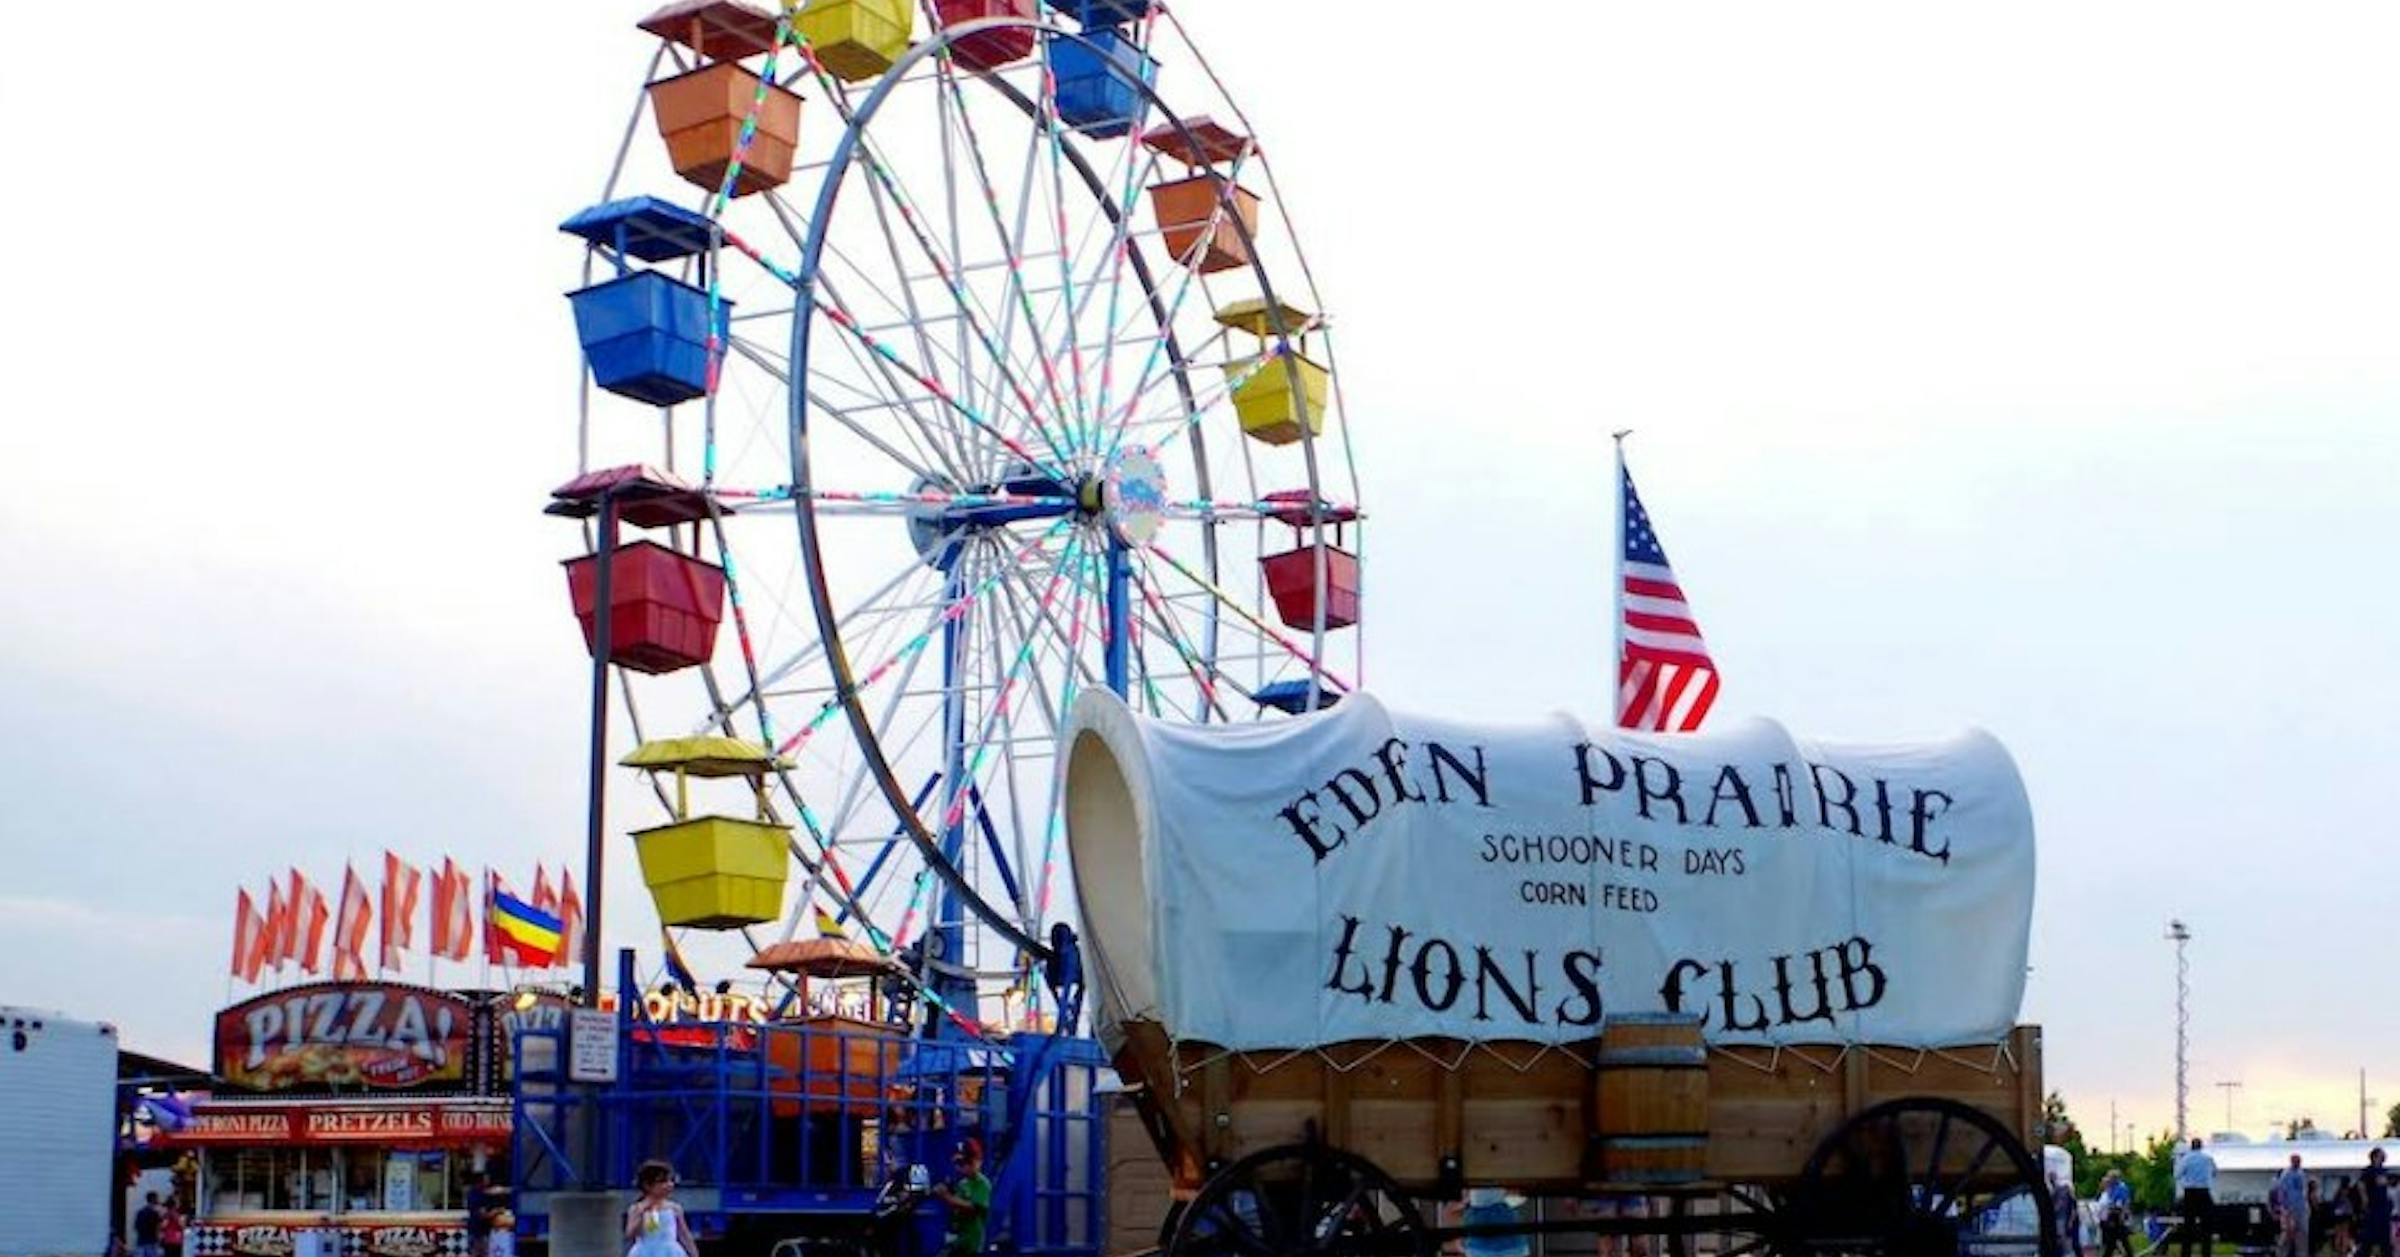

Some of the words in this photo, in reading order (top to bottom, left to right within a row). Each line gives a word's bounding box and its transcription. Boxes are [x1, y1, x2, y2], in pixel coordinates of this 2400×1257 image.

[1274, 737, 1497, 866] EDEN
[1572, 741, 1954, 866] PRAIRIE
[1480, 833, 1659, 873] SCHOONER
[1684, 848, 1746, 875] DAYS
[1520, 880, 1587, 907] CORN
[1602, 883, 1659, 913] FEED
[1323, 914, 1603, 1028] LIONS
[1658, 936, 1888, 1036] CLUB
[632, 988, 770, 1024] ONUTS
[244, 990, 454, 1071] PIZZA!
[308, 1110, 432, 1132] PRETZELS
[441, 1112, 475, 1130] COLD
